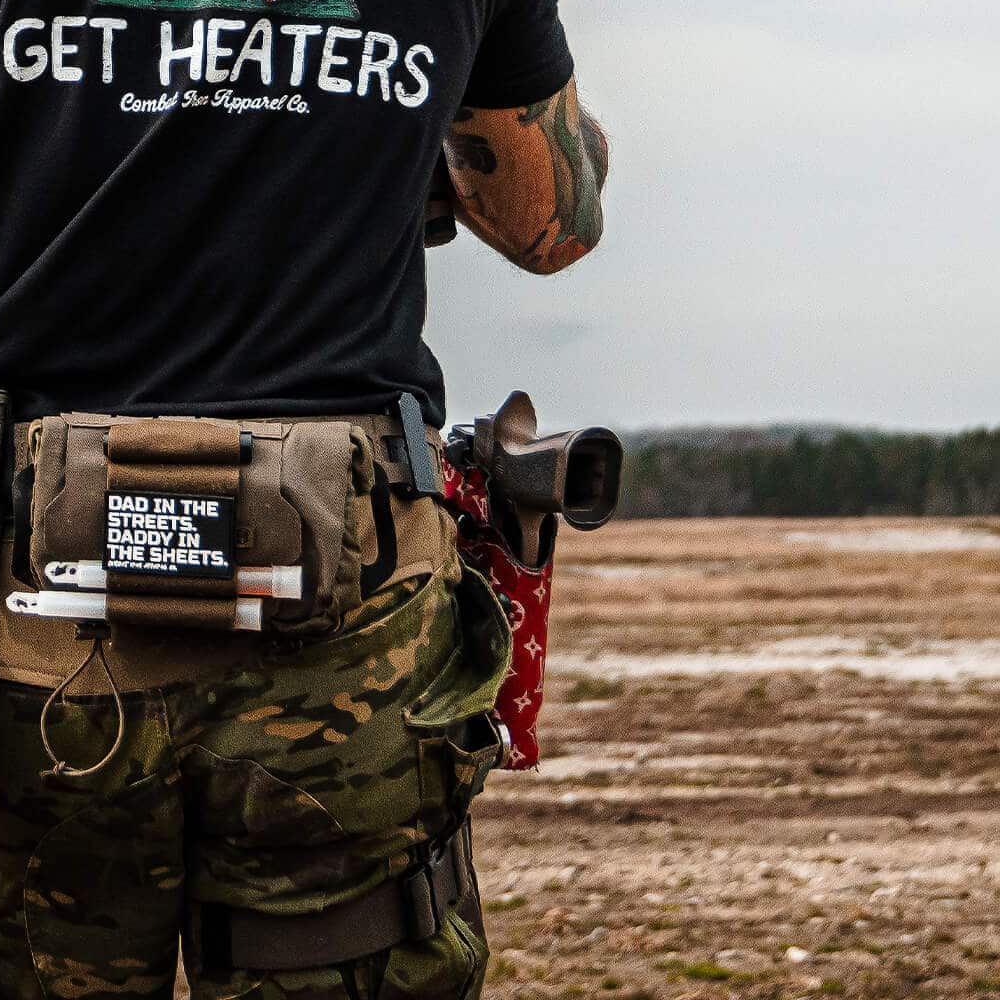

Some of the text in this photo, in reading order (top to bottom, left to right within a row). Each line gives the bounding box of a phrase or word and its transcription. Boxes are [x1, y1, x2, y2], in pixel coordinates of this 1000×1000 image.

[3, 15, 436, 108] GET HEATERS
[210, 89, 287, 114] Apparel
[286, 94, 310, 114] Co.
[108, 495, 219, 517] DAD IN THE
[107, 511, 197, 532] STREETS.
[107, 527, 200, 548] DADDY IN
[106, 544, 145, 561] THE
[149, 547, 229, 567] SHEETS.
